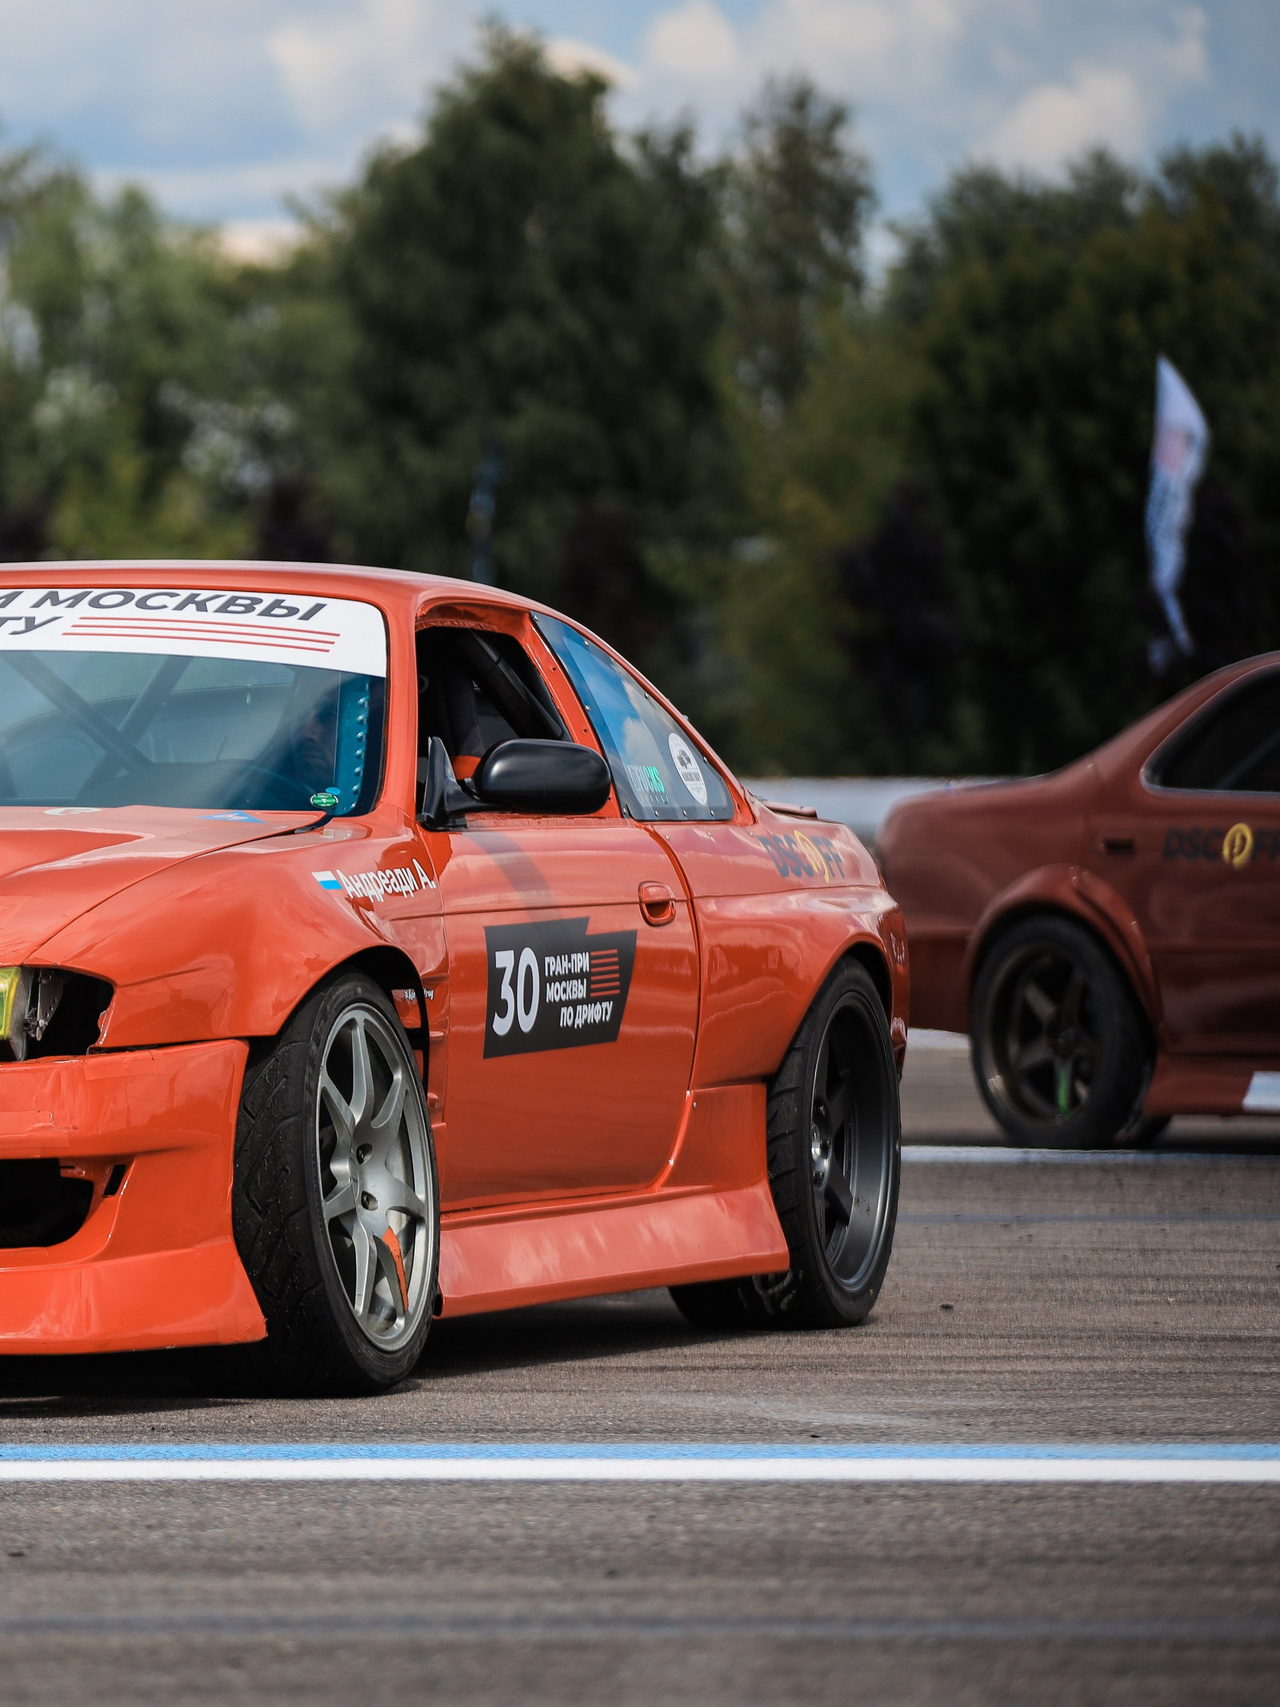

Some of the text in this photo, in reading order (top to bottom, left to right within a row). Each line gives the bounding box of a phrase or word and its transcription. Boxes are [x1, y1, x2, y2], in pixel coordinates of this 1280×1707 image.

[30, 590, 328, 622] МОСКВЫ
[335, 858, 437, 903] Андреади А.
[544, 951, 590, 977] ГРАН-ПРИ
[492, 946, 540, 1037] 30
[545, 978, 587, 1004] МОСКВЫ
[559, 1000, 614, 1030] ПО ДРИФТУ
